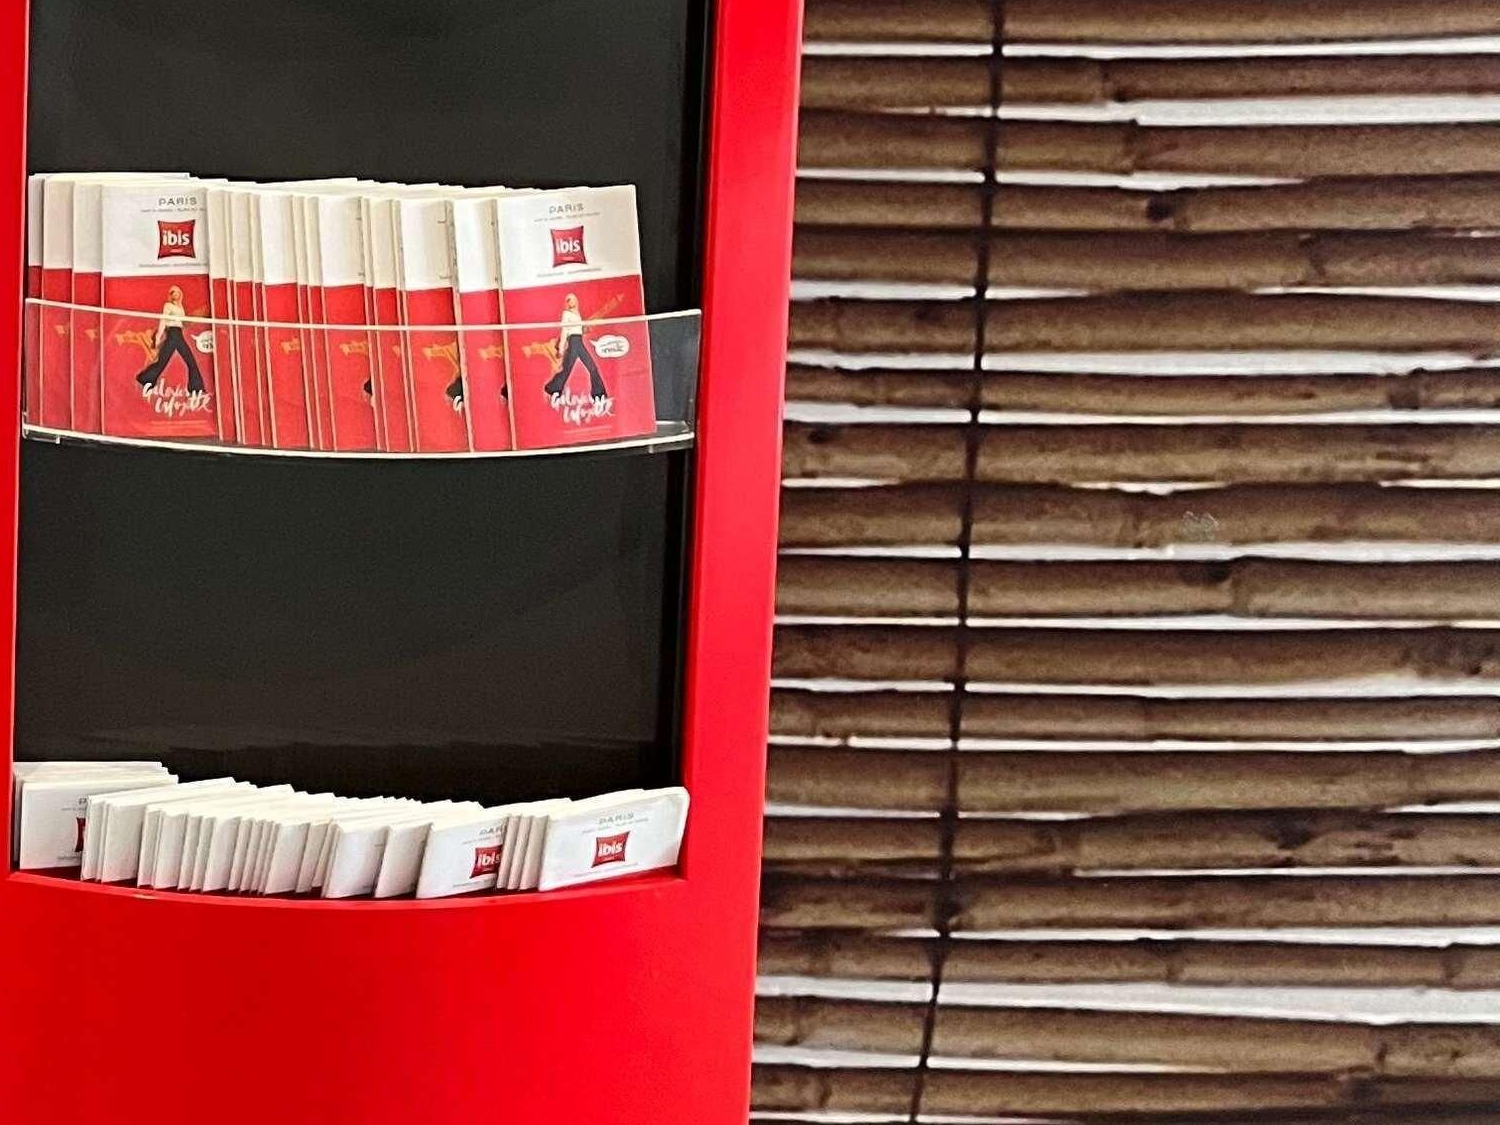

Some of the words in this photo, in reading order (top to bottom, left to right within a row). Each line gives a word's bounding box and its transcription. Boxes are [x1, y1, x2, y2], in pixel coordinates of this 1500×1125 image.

[158, 196, 197, 206] PARIS
[548, 202, 584, 214] PARIS
[162, 229, 190, 246] ibis
[555, 236, 581, 253] ibis
[598, 812, 636, 825] PARIS
[598, 840, 623, 857] ibis
